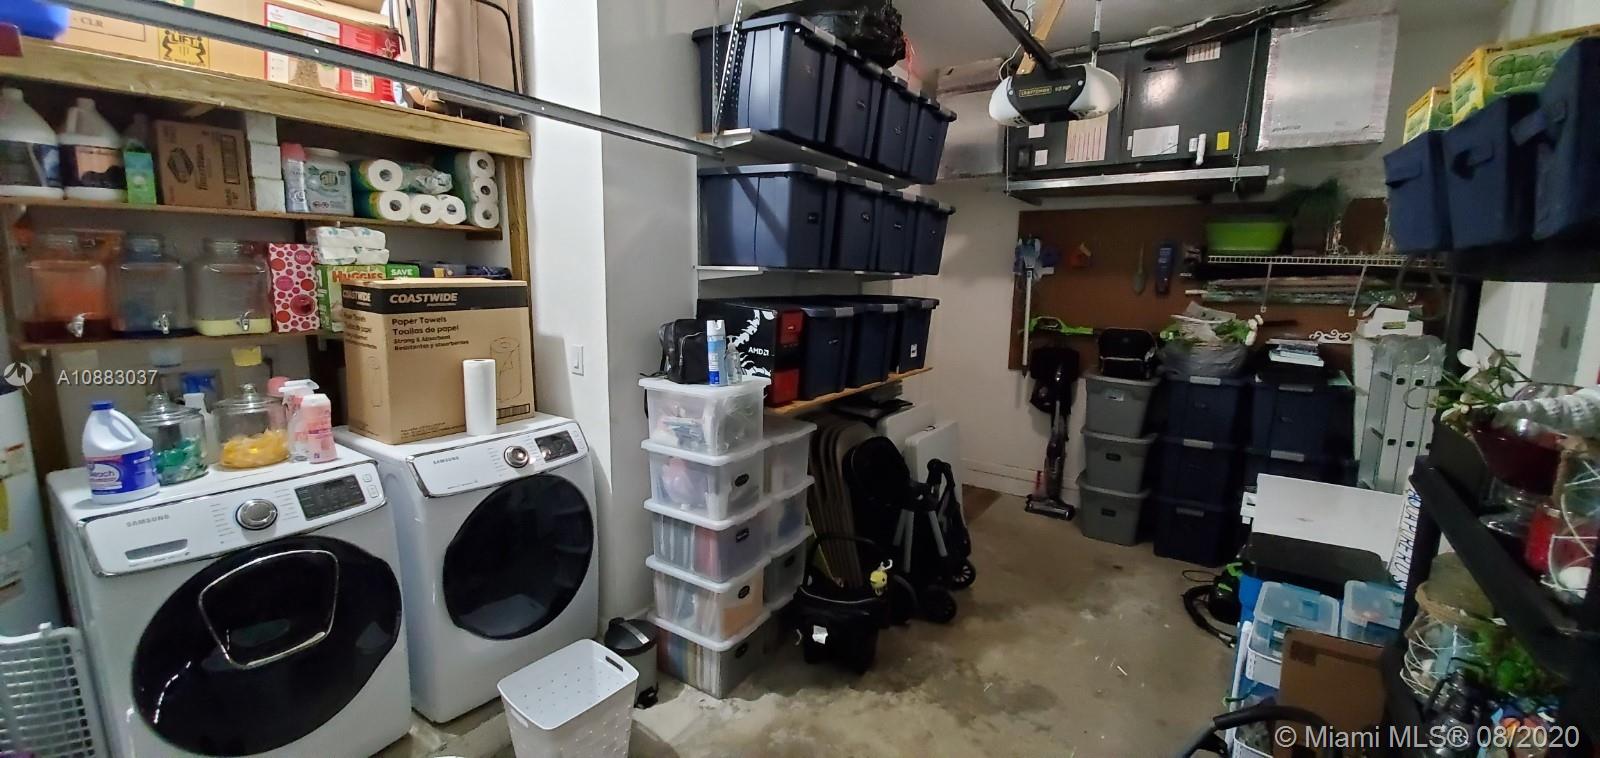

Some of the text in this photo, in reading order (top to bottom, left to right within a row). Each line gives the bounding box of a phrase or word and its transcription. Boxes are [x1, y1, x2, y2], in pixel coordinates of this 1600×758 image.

[171, 33, 196, 45] LIFT
[391, 268, 414, 277] SAVE
[389, 292, 459, 304] COASTWIDE
[391, 316, 447, 327] Paper Towels
[392, 324, 459, 335] Toallas de papel
[748, 346, 764, 355] AMD
[126, 514, 170, 527] SAMSUNG
